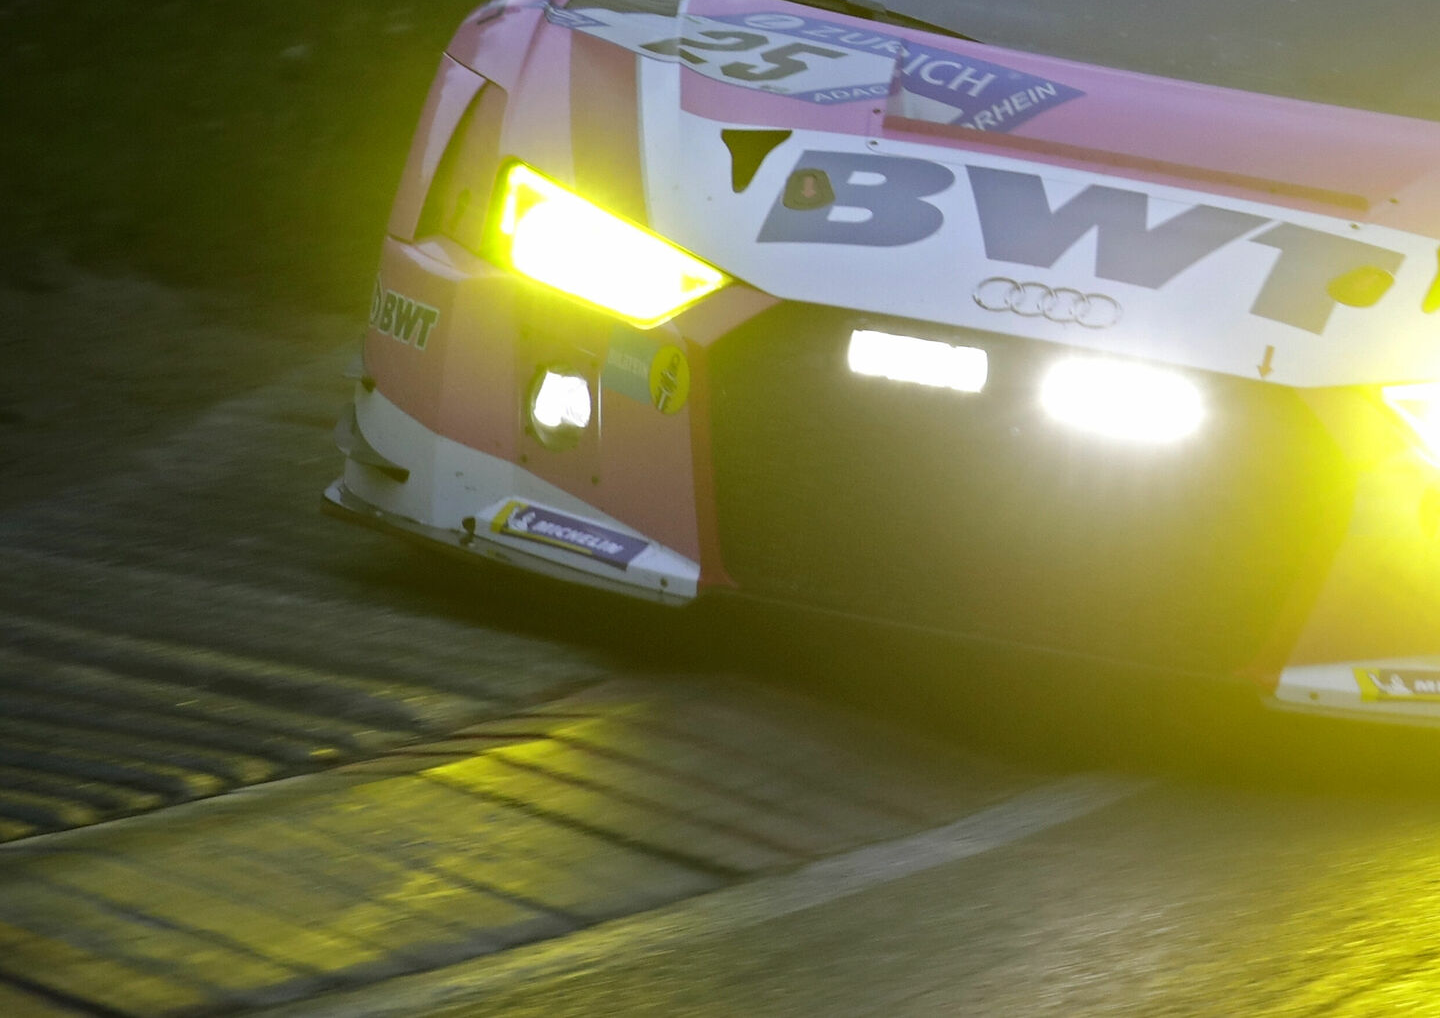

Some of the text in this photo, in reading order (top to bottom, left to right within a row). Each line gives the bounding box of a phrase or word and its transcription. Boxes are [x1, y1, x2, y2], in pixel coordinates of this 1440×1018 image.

[637, 29, 849, 82] 25
[802, 25, 998, 98] ZURICH
[962, 81, 1059, 131] RHEIN
[756, 150, 1407, 336] BWT
[377, 288, 441, 351] BWT
[532, 520, 625, 555] MICHELIN
